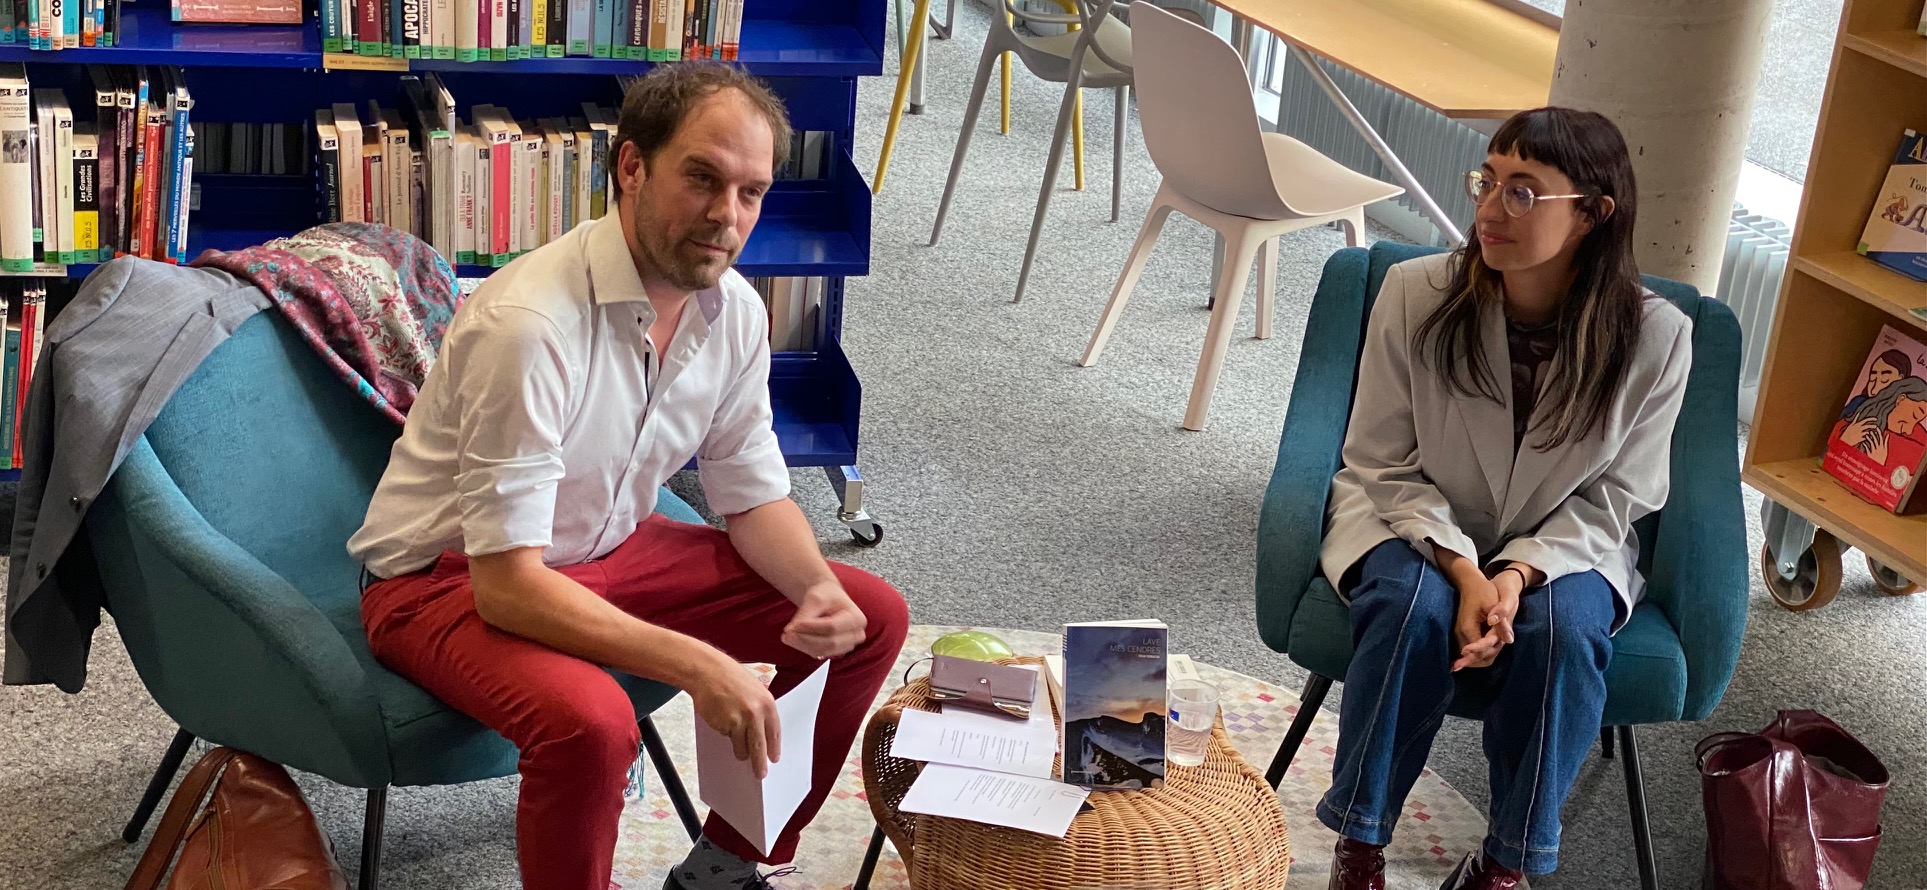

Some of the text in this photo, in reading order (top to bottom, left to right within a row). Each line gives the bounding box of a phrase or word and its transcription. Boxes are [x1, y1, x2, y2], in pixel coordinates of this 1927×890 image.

[366, 0, 375, 22] L'aigle
[536, 3, 545, 40] LES NULS
[633, 4, 643, 46] CHRONIQUES
[138, 144, 144, 153] DE
[136, 153, 144, 179] SECRETS
[326, 162, 335, 188] Journal
[85, 164, 93, 203] Civilisations
[175, 192, 180, 200] DU
[1109, 644, 1161, 655] MES CENDRES
